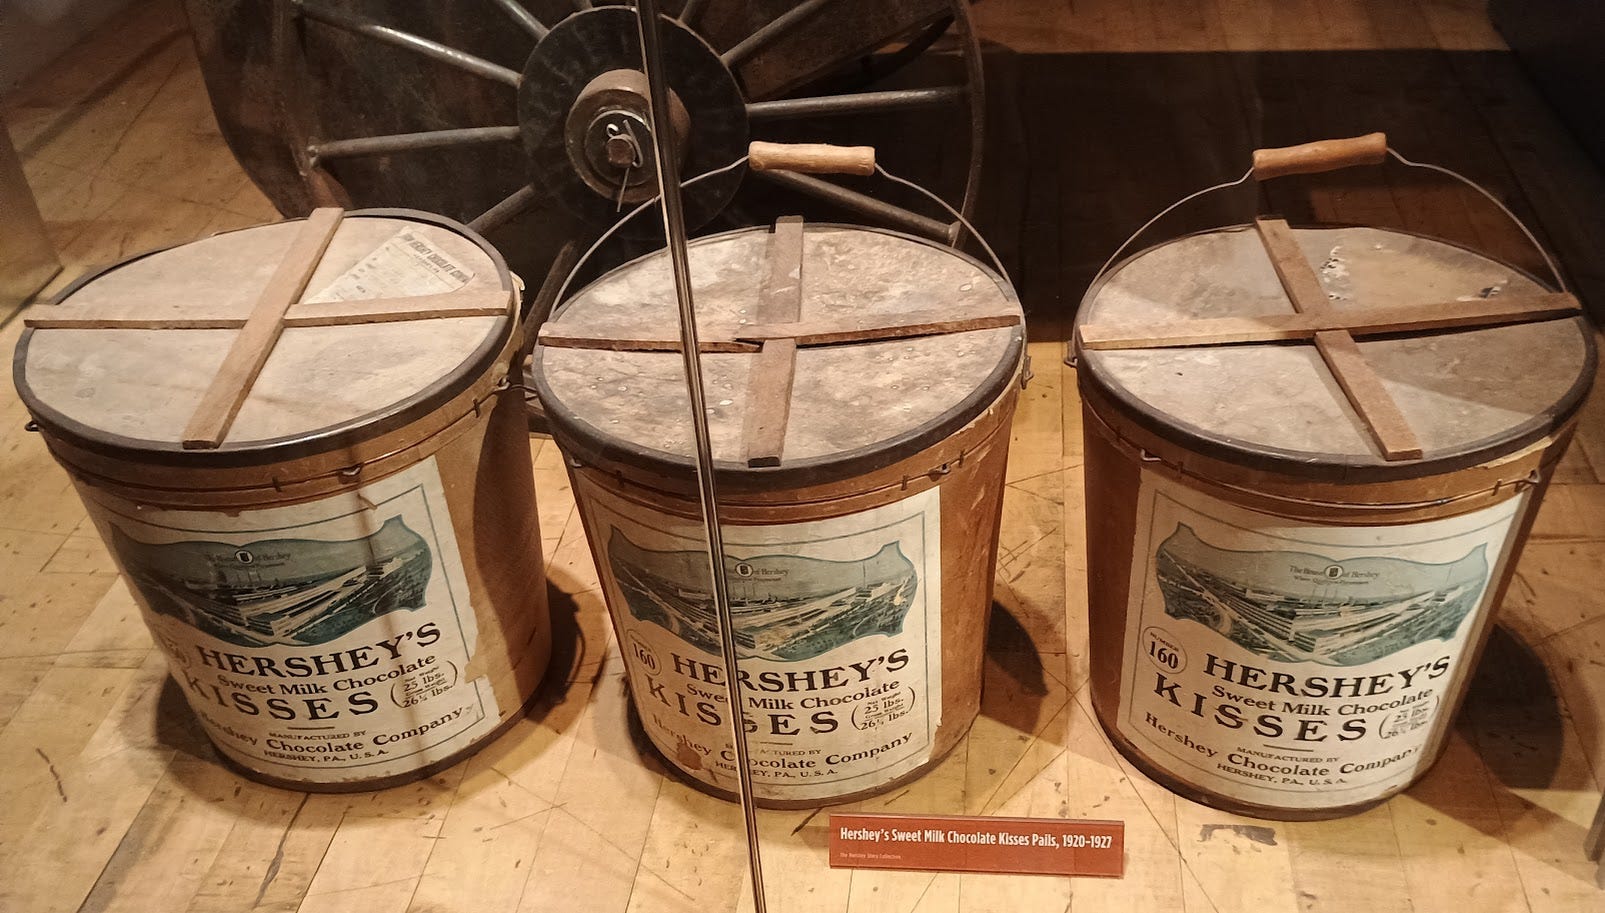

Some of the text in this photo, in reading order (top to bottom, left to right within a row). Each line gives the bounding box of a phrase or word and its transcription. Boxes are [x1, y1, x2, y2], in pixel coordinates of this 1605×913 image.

[195, 622, 441, 678] HERSHEY'S
[632, 642, 656, 670] 160
[1149, 641, 1179, 669] 160
[217, 674, 278, 695] Sweet
[279, 682, 329, 695] Milk
[333, 654, 436, 691] Chocolate
[403, 681, 419, 692] 25
[1203, 653, 1450, 698] HERSHEY'S
[182, 669, 379, 721] KISSES
[748, 696, 794, 710] Milk
[800, 681, 900, 709] Chocolate
[864, 699, 904, 715] 25 lbs.
[1154, 671, 1367, 742] KISSES
[1212, 685, 1277, 712] Sweet
[1282, 702, 1331, 716] Milk
[1337, 688, 1433, 716] Chocolate
[266, 738, 365, 754] Chocolate
[372, 707, 463, 746] Company
[888, 711, 909, 722] lbs.
[268, 732, 350, 741] MANUFACTURED
[720, 749, 817, 769] Cocolate
[825, 732, 913, 766] Company
[1144, 711, 1219, 758] Hershey
[1228, 753, 1330, 777] Chocolate
[1237, 746, 1324, 763] MANUFACTURED
[840, 827, 890, 843] Hershey's
[892, 829, 921, 842] Sweet
[924, 830, 945, 843] Milk
[947, 831, 997, 844] Chocolate
[999, 832, 1030, 846] Kisses
[1032, 833, 1060, 850] Pails,
